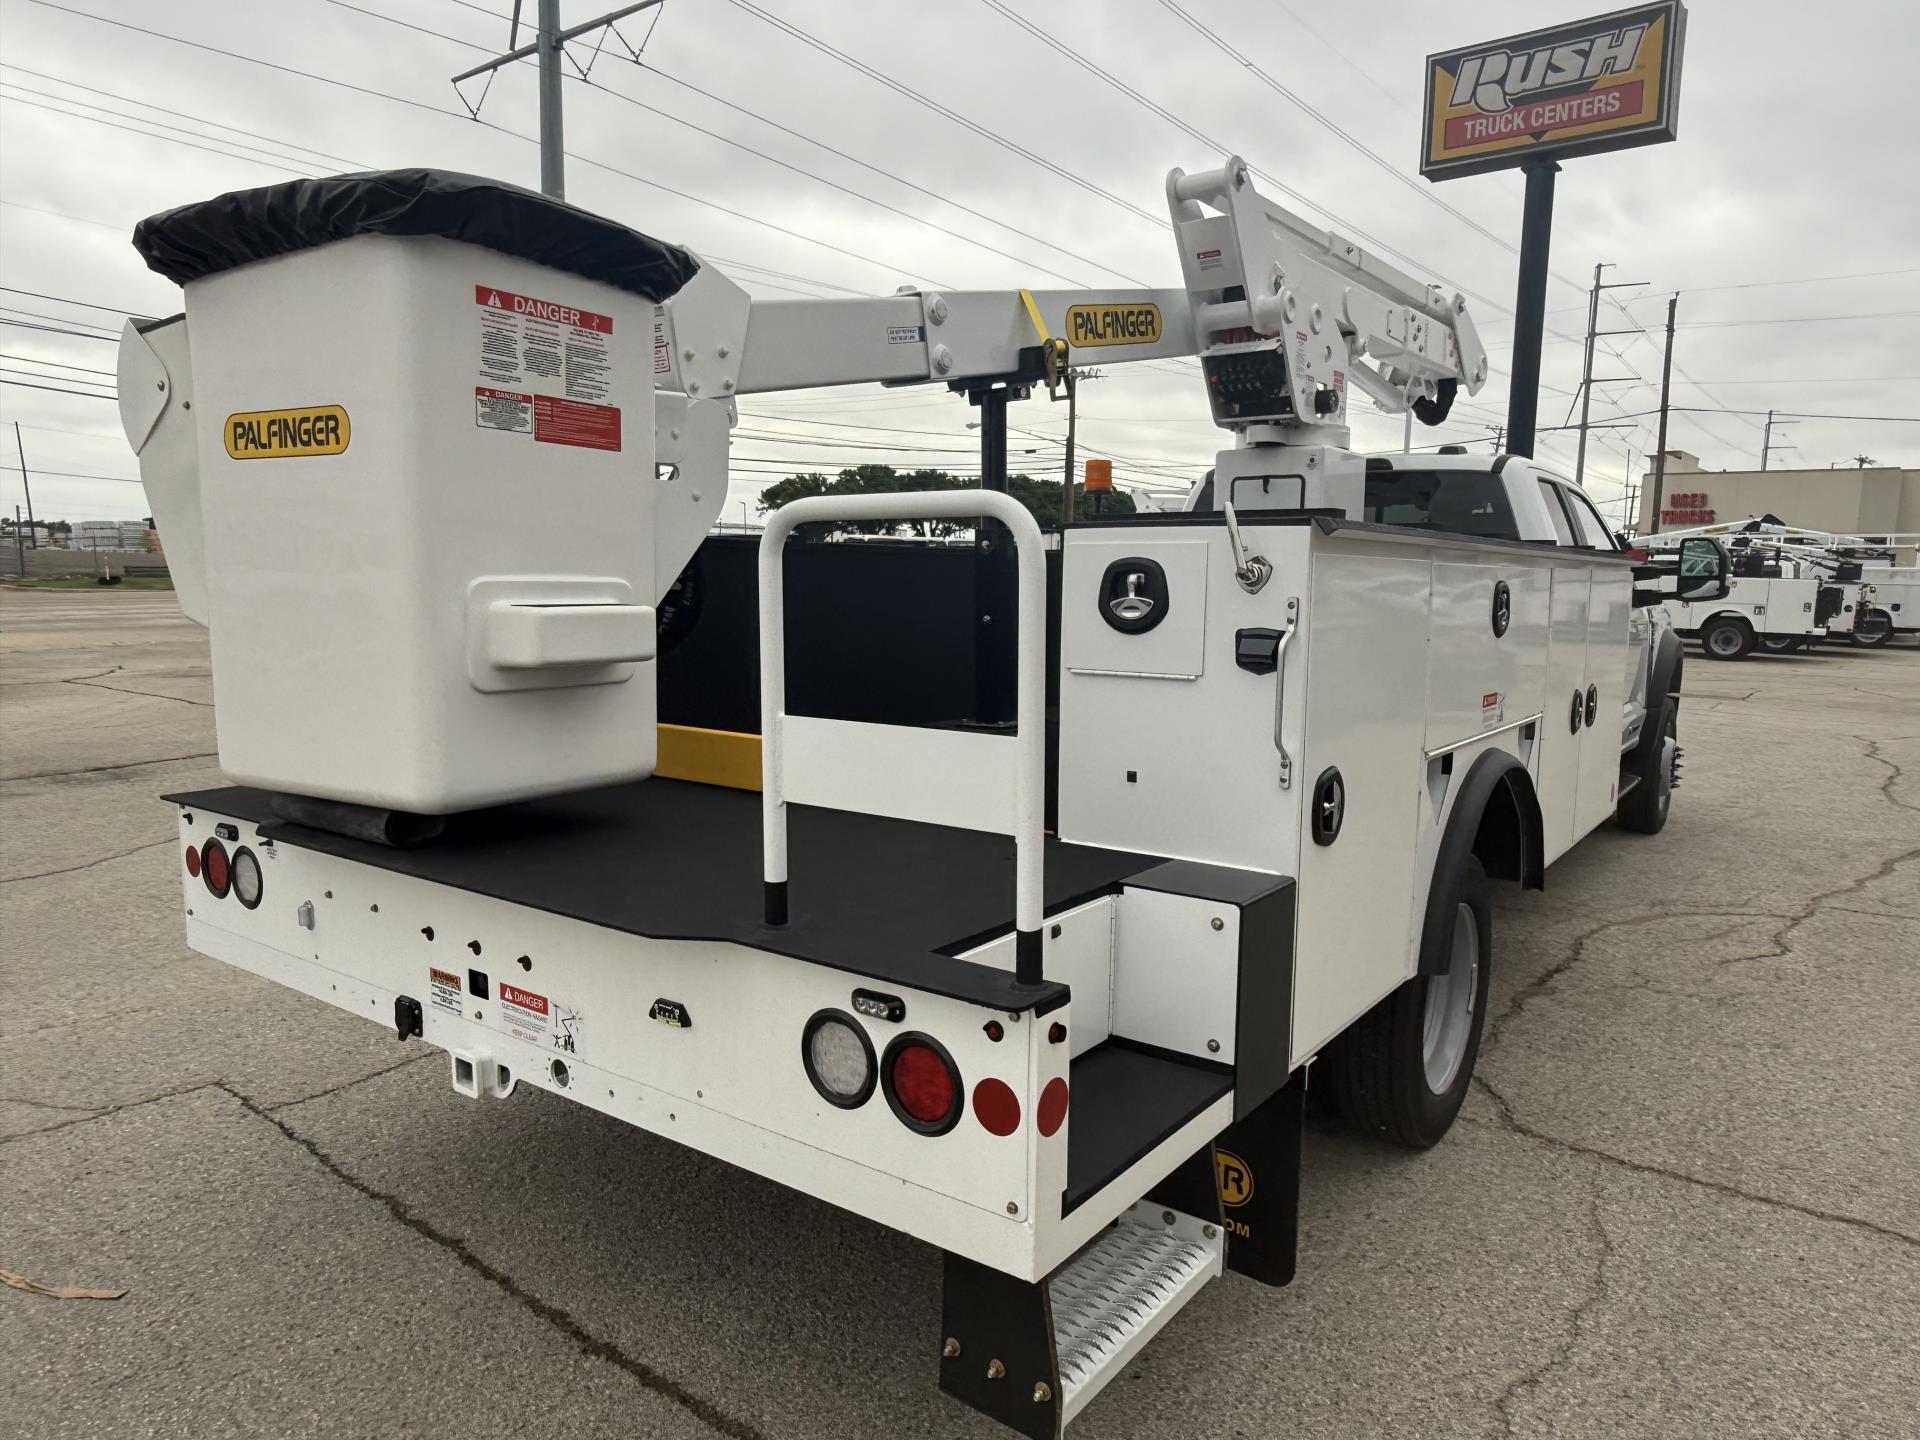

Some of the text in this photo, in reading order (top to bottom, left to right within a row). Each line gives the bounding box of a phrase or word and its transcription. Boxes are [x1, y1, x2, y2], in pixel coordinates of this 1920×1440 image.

[1449, 22, 1650, 115] RUSH
[1464, 91, 1621, 139] TRUCK CENTERS
[514, 296, 581, 326] DANGER
[1073, 309, 1156, 341] PALFINGER
[495, 390, 523, 401] DANGER
[232, 414, 341, 451] PALFINGER
[514, 991, 544, 1011] DANGER
[1225, 1218, 1250, 1238] OM
